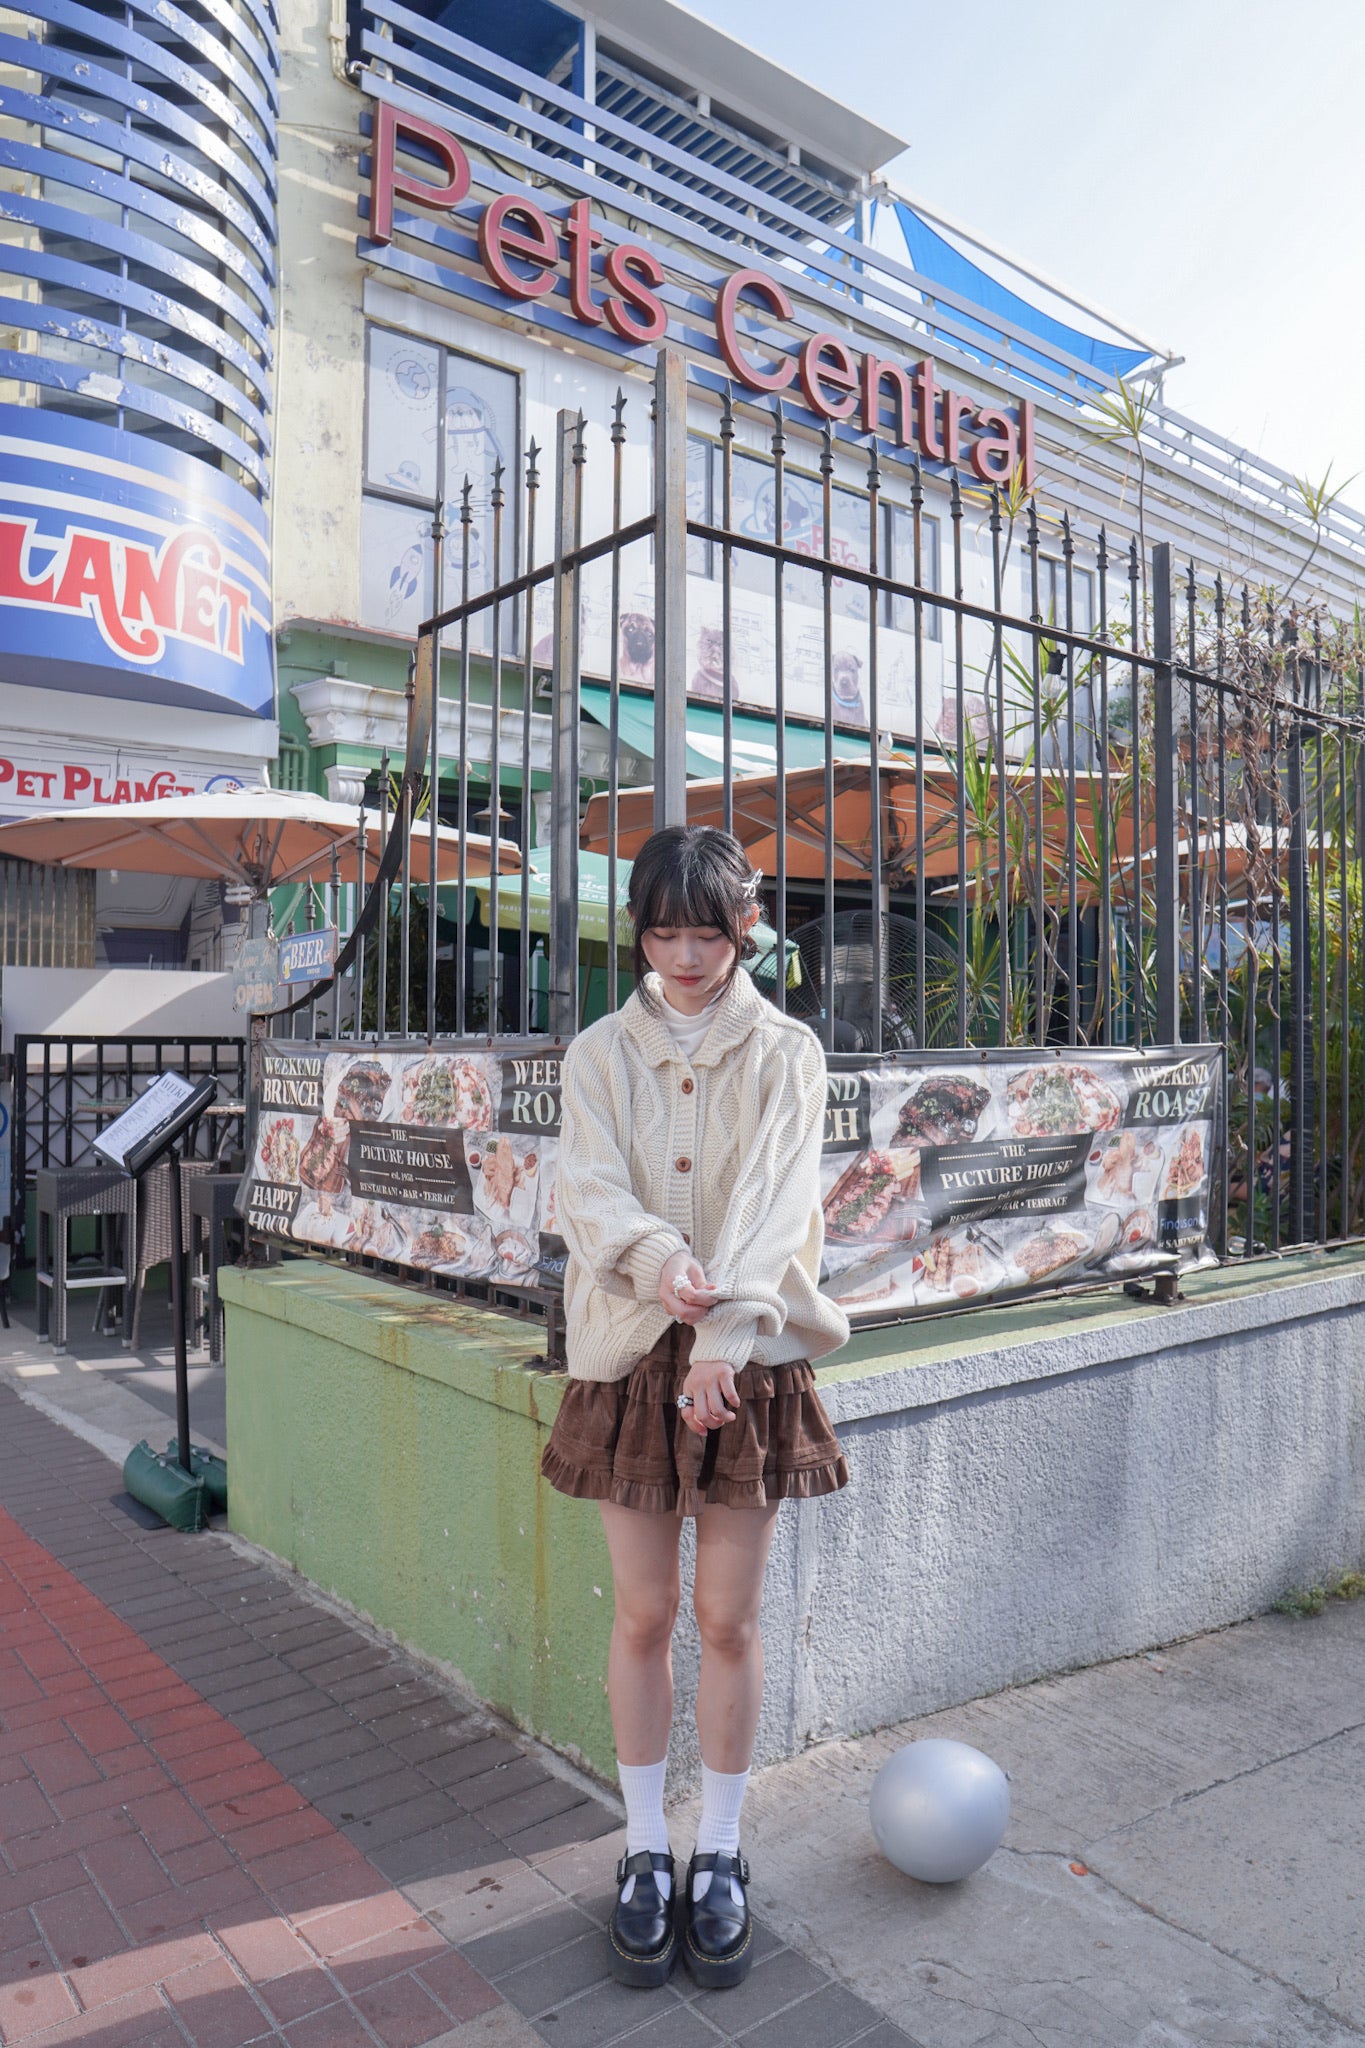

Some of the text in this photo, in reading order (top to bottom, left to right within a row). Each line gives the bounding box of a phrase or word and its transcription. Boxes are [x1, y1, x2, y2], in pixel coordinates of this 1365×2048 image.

[369, 100, 1036, 494] Pets Central
[290, 939, 324, 970] BEER
[264, 1056, 321, 1077] WEEKEND
[1132, 1063, 1210, 1088] WEEKEND
[262, 1078, 319, 1107] BRUNCH
[1132, 1086, 1211, 1119] ROAST
[391, 1129, 408, 1142] THE
[360, 1144, 454, 1169] PICTURE HOUSE
[1000, 1144, 1026, 1158] THE
[940, 1159, 1073, 1190] PICTURE HOUSE
[251, 1185, 299, 1213] HAPPY
[402, 1188, 419, 1200] BAR
[422, 1191, 455, 1205] TERRACE
[1027, 1196, 1067, 1210] TERRACE
